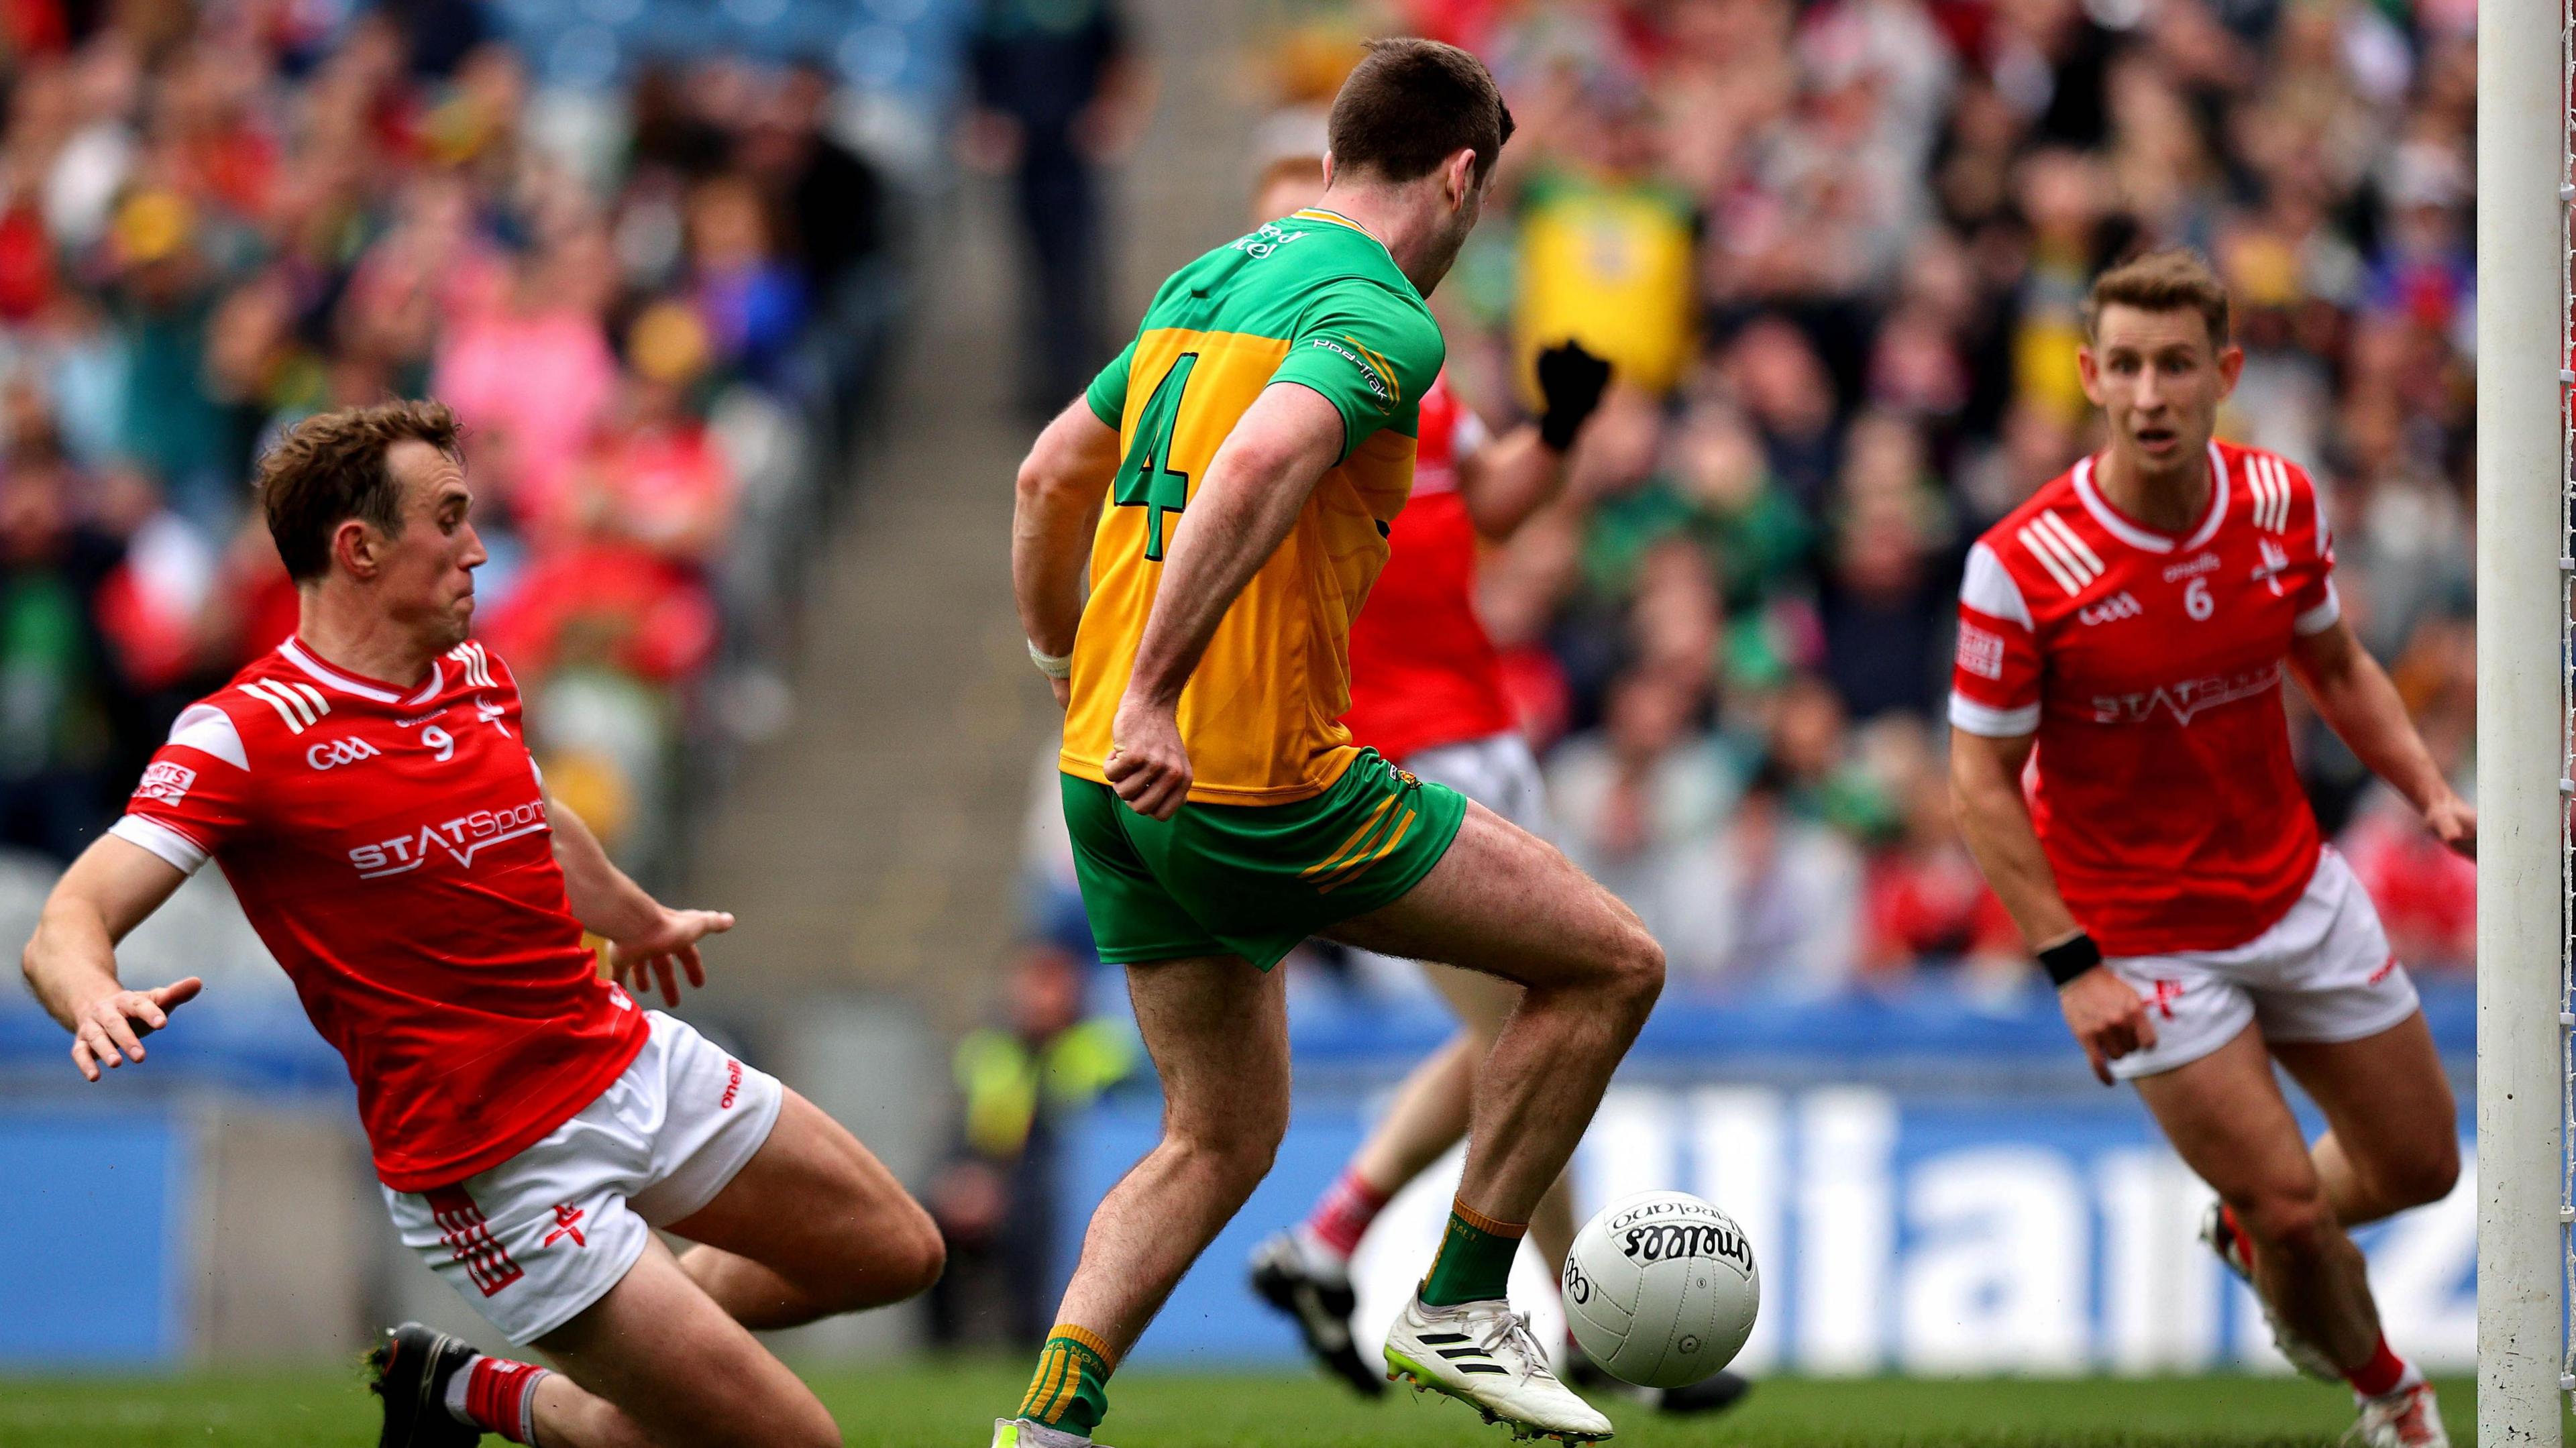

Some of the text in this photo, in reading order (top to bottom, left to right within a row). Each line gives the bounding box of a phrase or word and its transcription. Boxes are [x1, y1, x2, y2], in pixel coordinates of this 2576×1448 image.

[1114, 352, 1199, 561] 4
[2184, 576, 2214, 621] 6
[421, 725, 454, 763] 9
